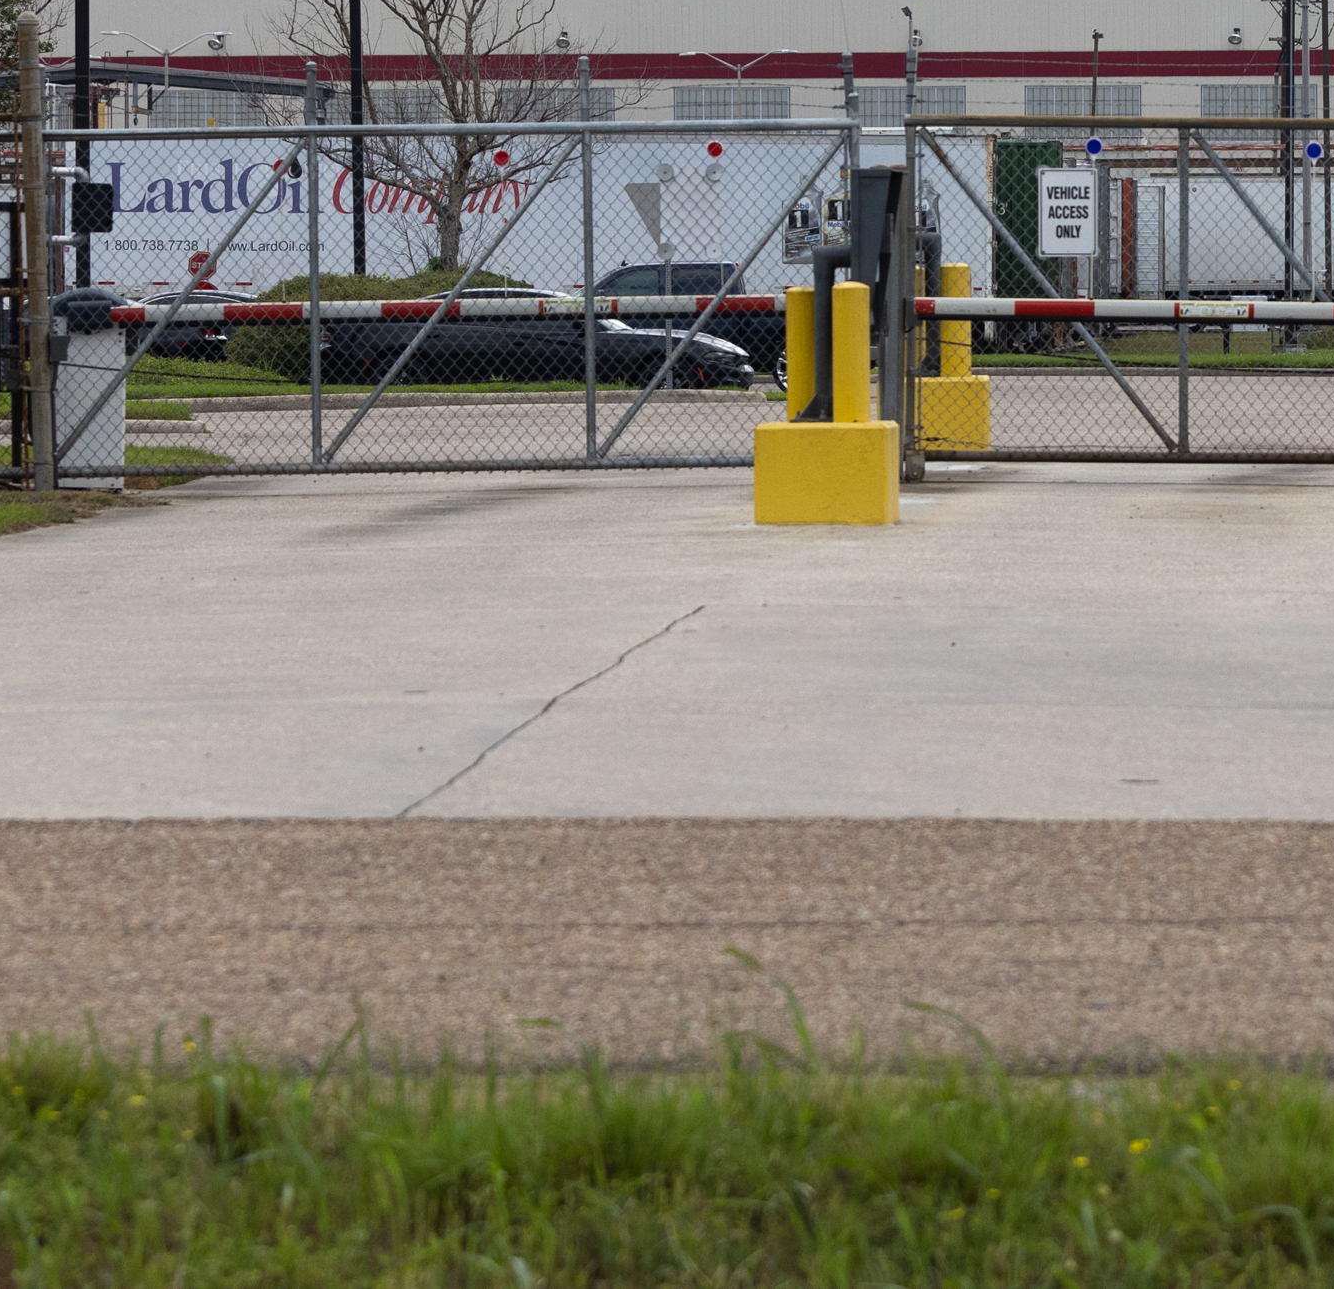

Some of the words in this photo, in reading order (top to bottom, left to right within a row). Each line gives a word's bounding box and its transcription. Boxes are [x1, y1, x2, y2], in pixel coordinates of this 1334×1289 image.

[106, 158, 324, 214] LardOi
[1046, 186, 1090, 199] VEHICLE
[1048, 206, 1089, 219] ACCESS
[1056, 225, 1081, 238] ONLY
[104, 239, 199, 251] 1.800.738.7738
